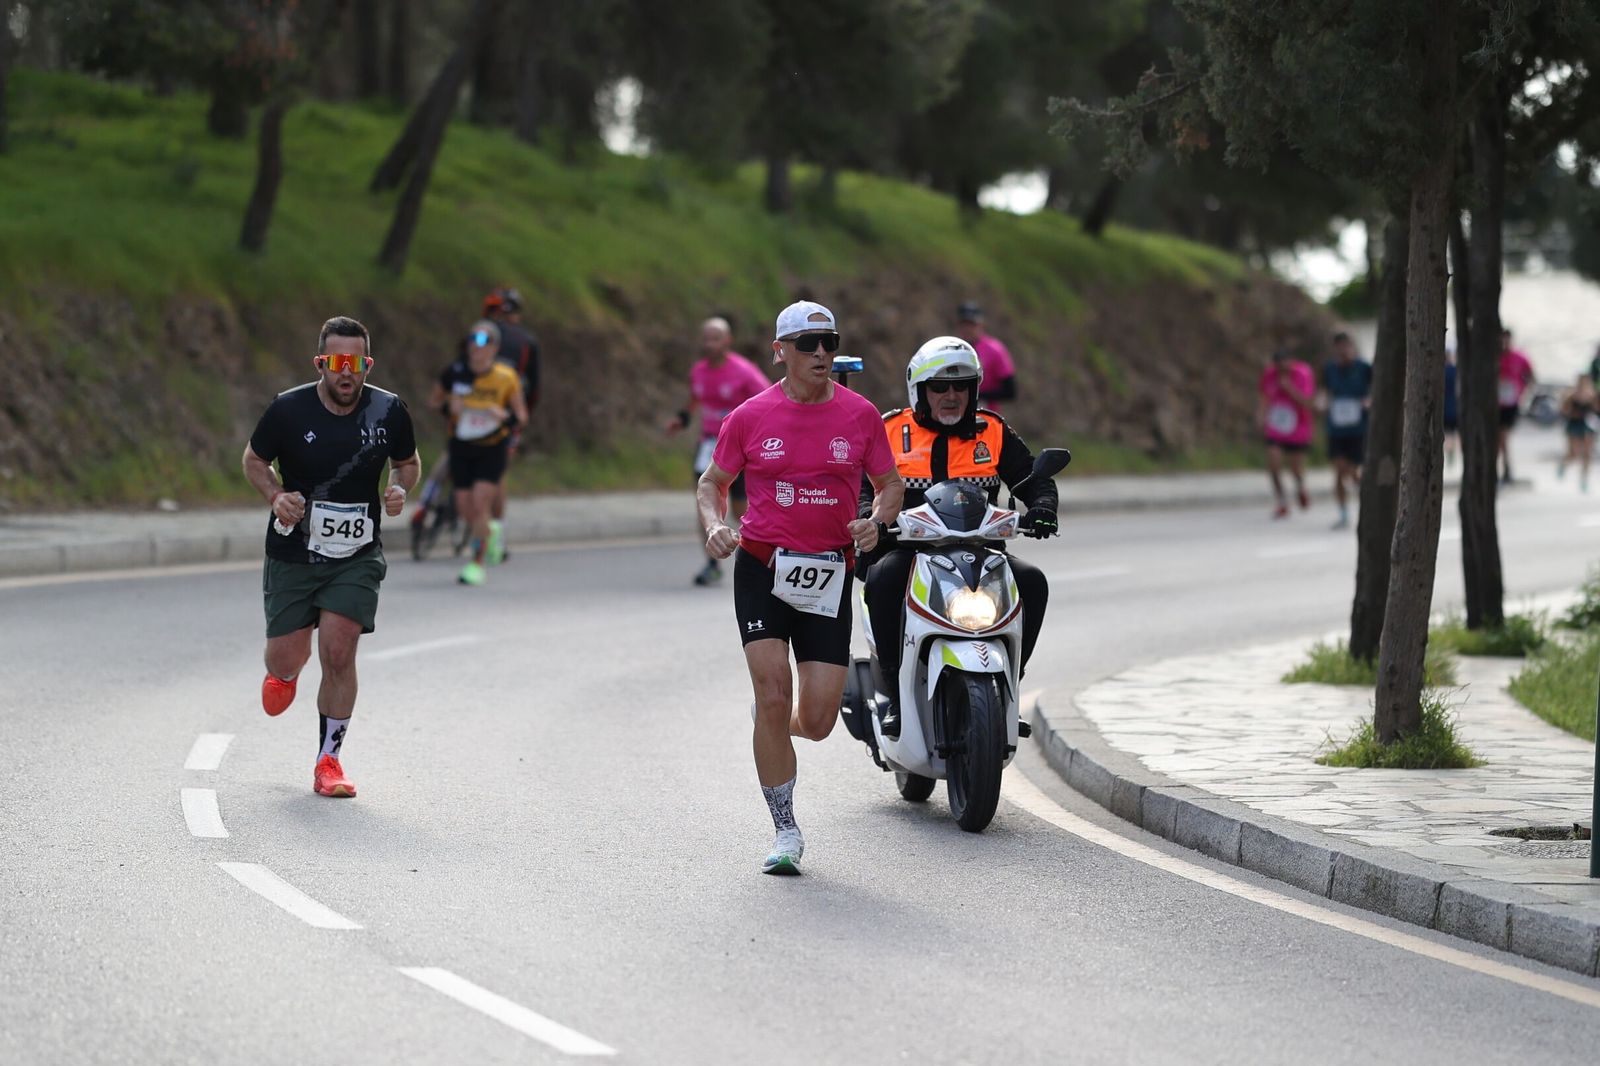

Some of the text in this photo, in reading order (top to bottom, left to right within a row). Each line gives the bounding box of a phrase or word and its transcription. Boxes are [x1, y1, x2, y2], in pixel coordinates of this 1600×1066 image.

[798, 488, 827, 496] Ciudad
[798, 496, 838, 506] de Málaga
[321, 517, 365, 539] 548
[785, 566, 836, 591] 497
